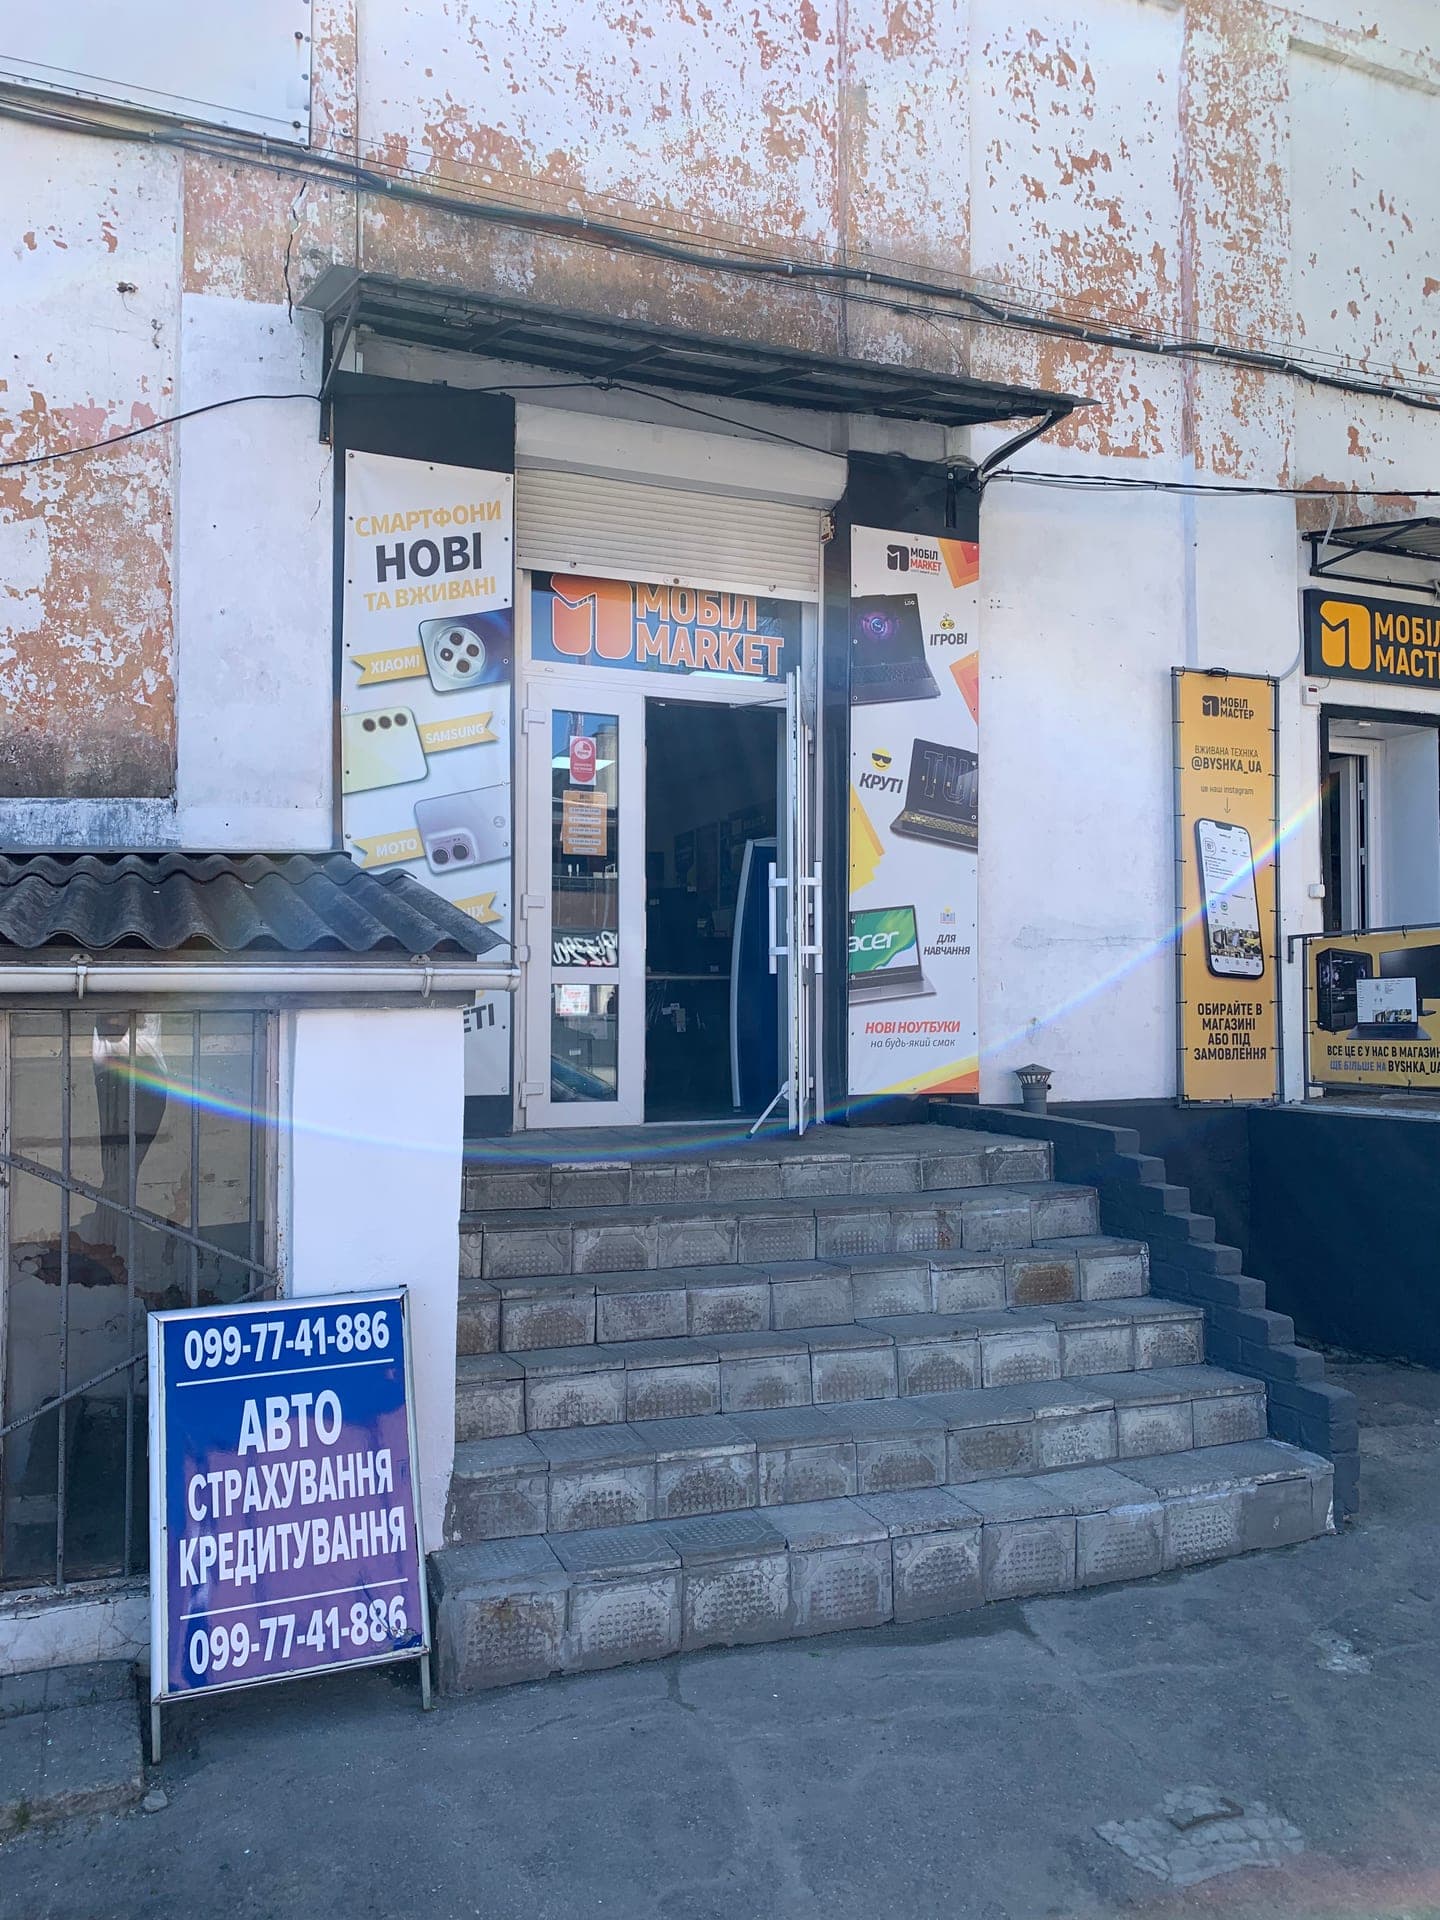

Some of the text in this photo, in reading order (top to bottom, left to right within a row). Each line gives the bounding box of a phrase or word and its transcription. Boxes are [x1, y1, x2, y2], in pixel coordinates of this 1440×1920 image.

[355, 500, 502, 537] СМАРТФОНИ
[375, 532, 482, 583] НОВІ
[910, 547, 938, 560] МОБІЛ
[910, 559, 942, 572] MARKET
[364, 576, 496, 612] ТА ВЖИВАНІ
[636, 583, 757, 632] МОБІЛ
[636, 622, 785, 676] MARKET
[930, 633, 968, 646] ІГРОВІ
[370, 654, 420, 675] XIAOMI
[1375, 644, 1440, 680] МАСТ
[1220, 696, 1248, 709] МОБІЛ
[1220, 707, 1254, 720] МАСТЕР
[425, 723, 485, 745] SAMSUNG
[1194, 745, 1259, 758] ВЖИВАНА ТЕХНІКА
[1191, 756, 1262, 775] @BYSHKA_UA
[859, 772, 904, 794] КРУТІ
[375, 838, 417, 859] MOTO
[849, 931, 900, 953] acer
[936, 934, 957, 945] ДЛЯ
[924, 945, 971, 956] НАВЧАННЯ
[1197, 1000, 1263, 1016] ОБИРАЙТЕ В
[865, 1020, 961, 1034] НОВІ НОУТБУКИ
[1202, 1017, 1256, 1031] МАГАЗИНІ
[870, 1037, 956, 1050] на будь-який смак
[1207, 1032, 1251, 1047] АБО ПІД
[1193, 1047, 1267, 1061] ЗАМОВЛЕННЯ
[1327, 1045, 1341, 1056] ВСЕ
[1345, 1046, 1355, 1058] ЦЕ
[1358, 1045, 1363, 1056] Є
[1365, 1046, 1370, 1057] У
[1372, 1046, 1389, 1057] НАС
[1391, 1046, 1397, 1057] В
[1330, 1060, 1342, 1072] ЩЕ
[1344, 1060, 1375, 1072] БІЛЬШЕ
[1376, 1061, 1386, 1072] НА
[184, 1310, 390, 1371] 099-77-41-886
[237, 1389, 343, 1456] АВТО
[187, 1448, 394, 1522] СТРАХУВАННЯ
[179, 1506, 407, 1588] КРЕДИТУВАННЯ
[189, 1594, 408, 1675] 099-77-41-886
